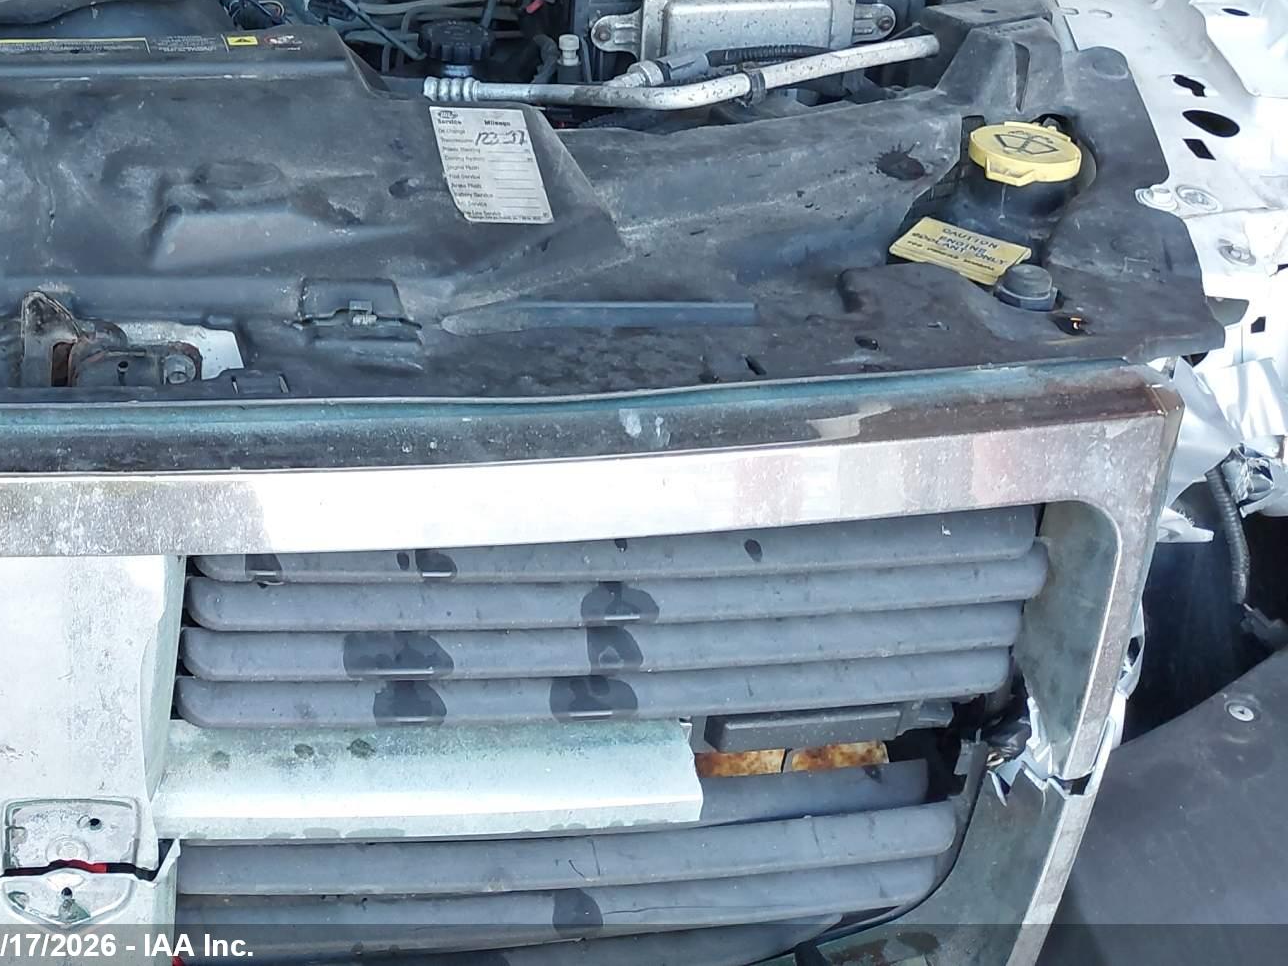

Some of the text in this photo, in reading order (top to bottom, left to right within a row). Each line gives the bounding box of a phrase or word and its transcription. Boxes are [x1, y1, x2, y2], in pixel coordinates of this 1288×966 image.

[938, 235, 987, 254] ENGINE
[942, 228, 998, 249] CAUTION
[974, 252, 1007, 266] ONLY
